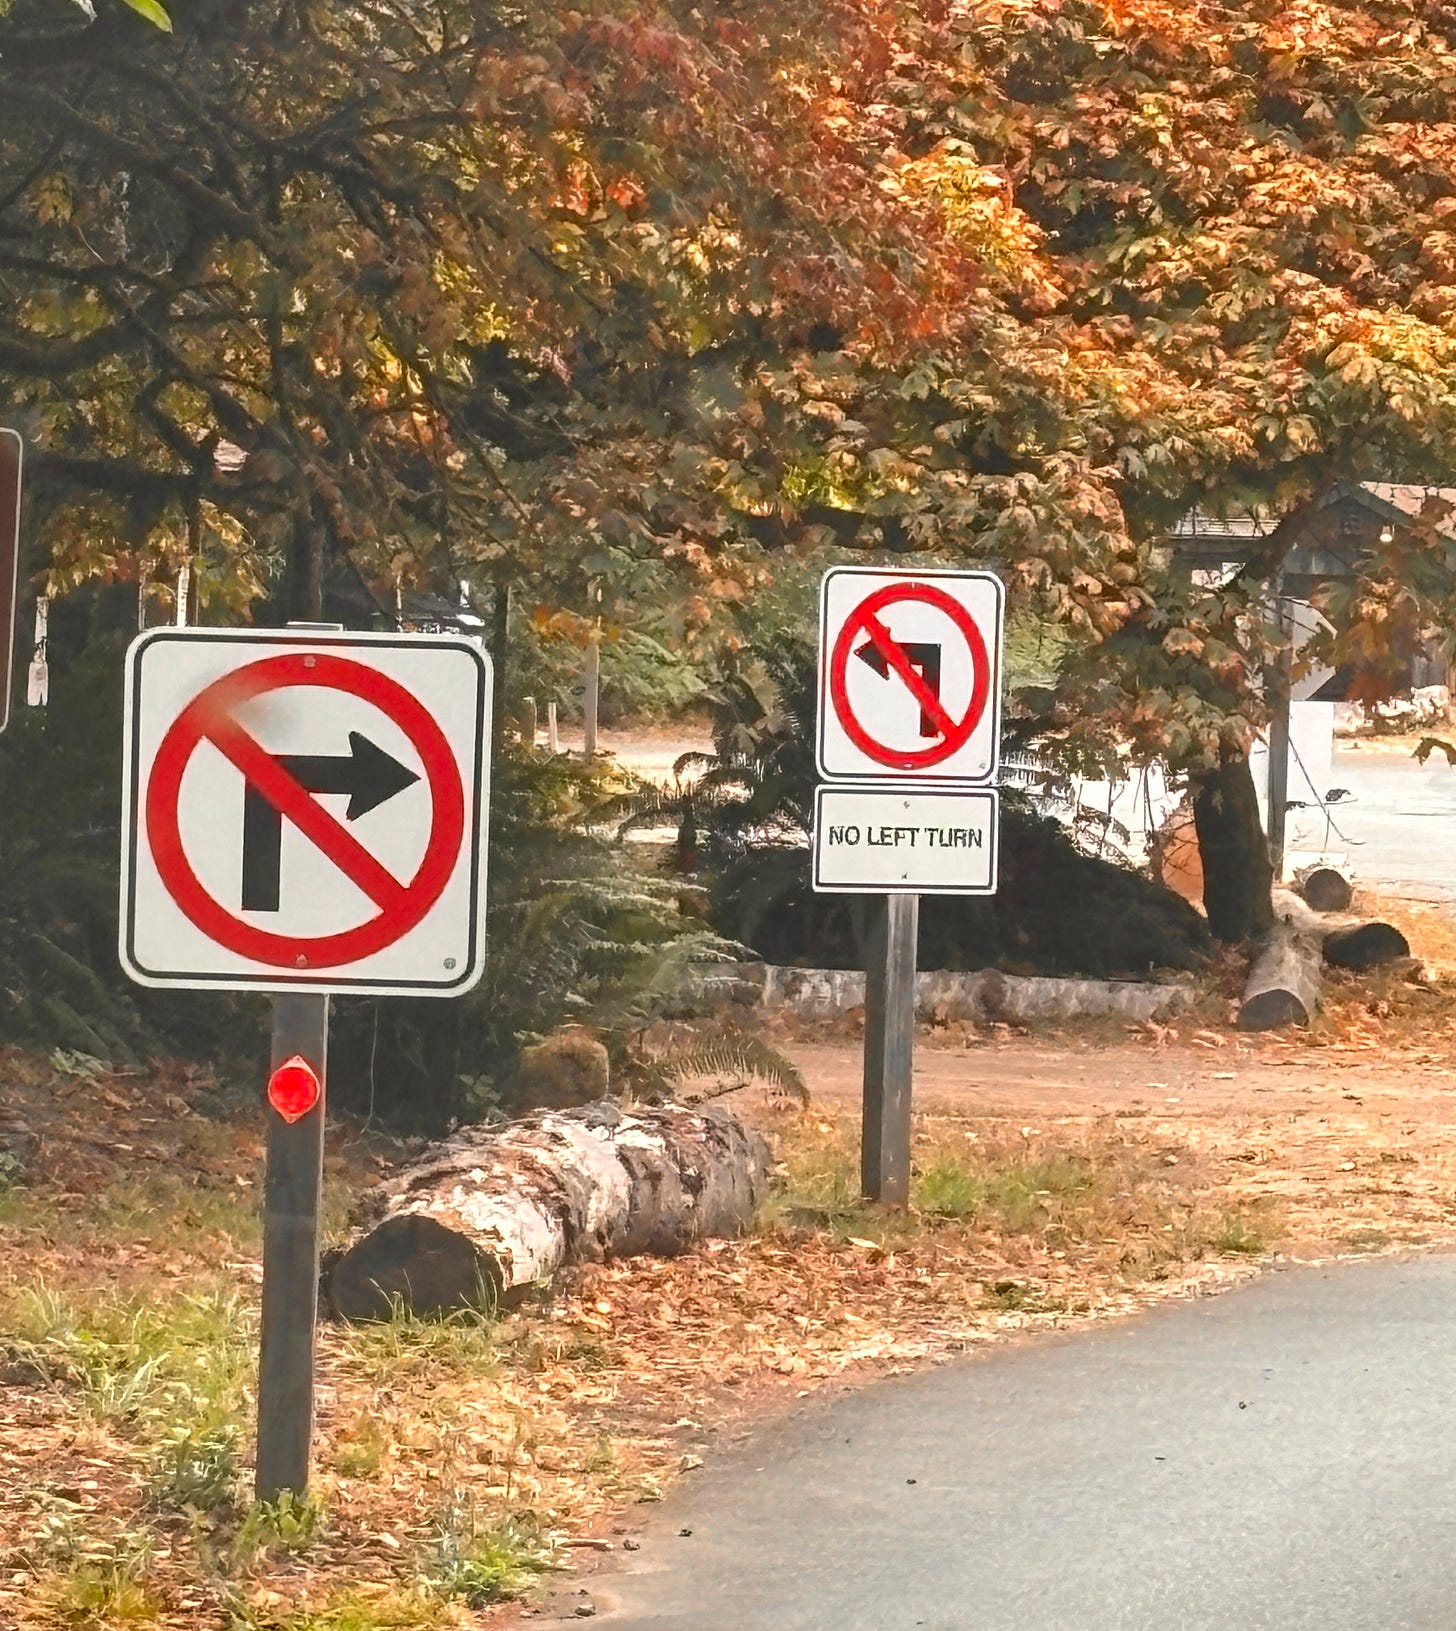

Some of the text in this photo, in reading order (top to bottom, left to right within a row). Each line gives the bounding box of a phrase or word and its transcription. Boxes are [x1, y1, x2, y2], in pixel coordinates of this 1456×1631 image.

[828, 825, 982, 848] NO LEFT TURN
